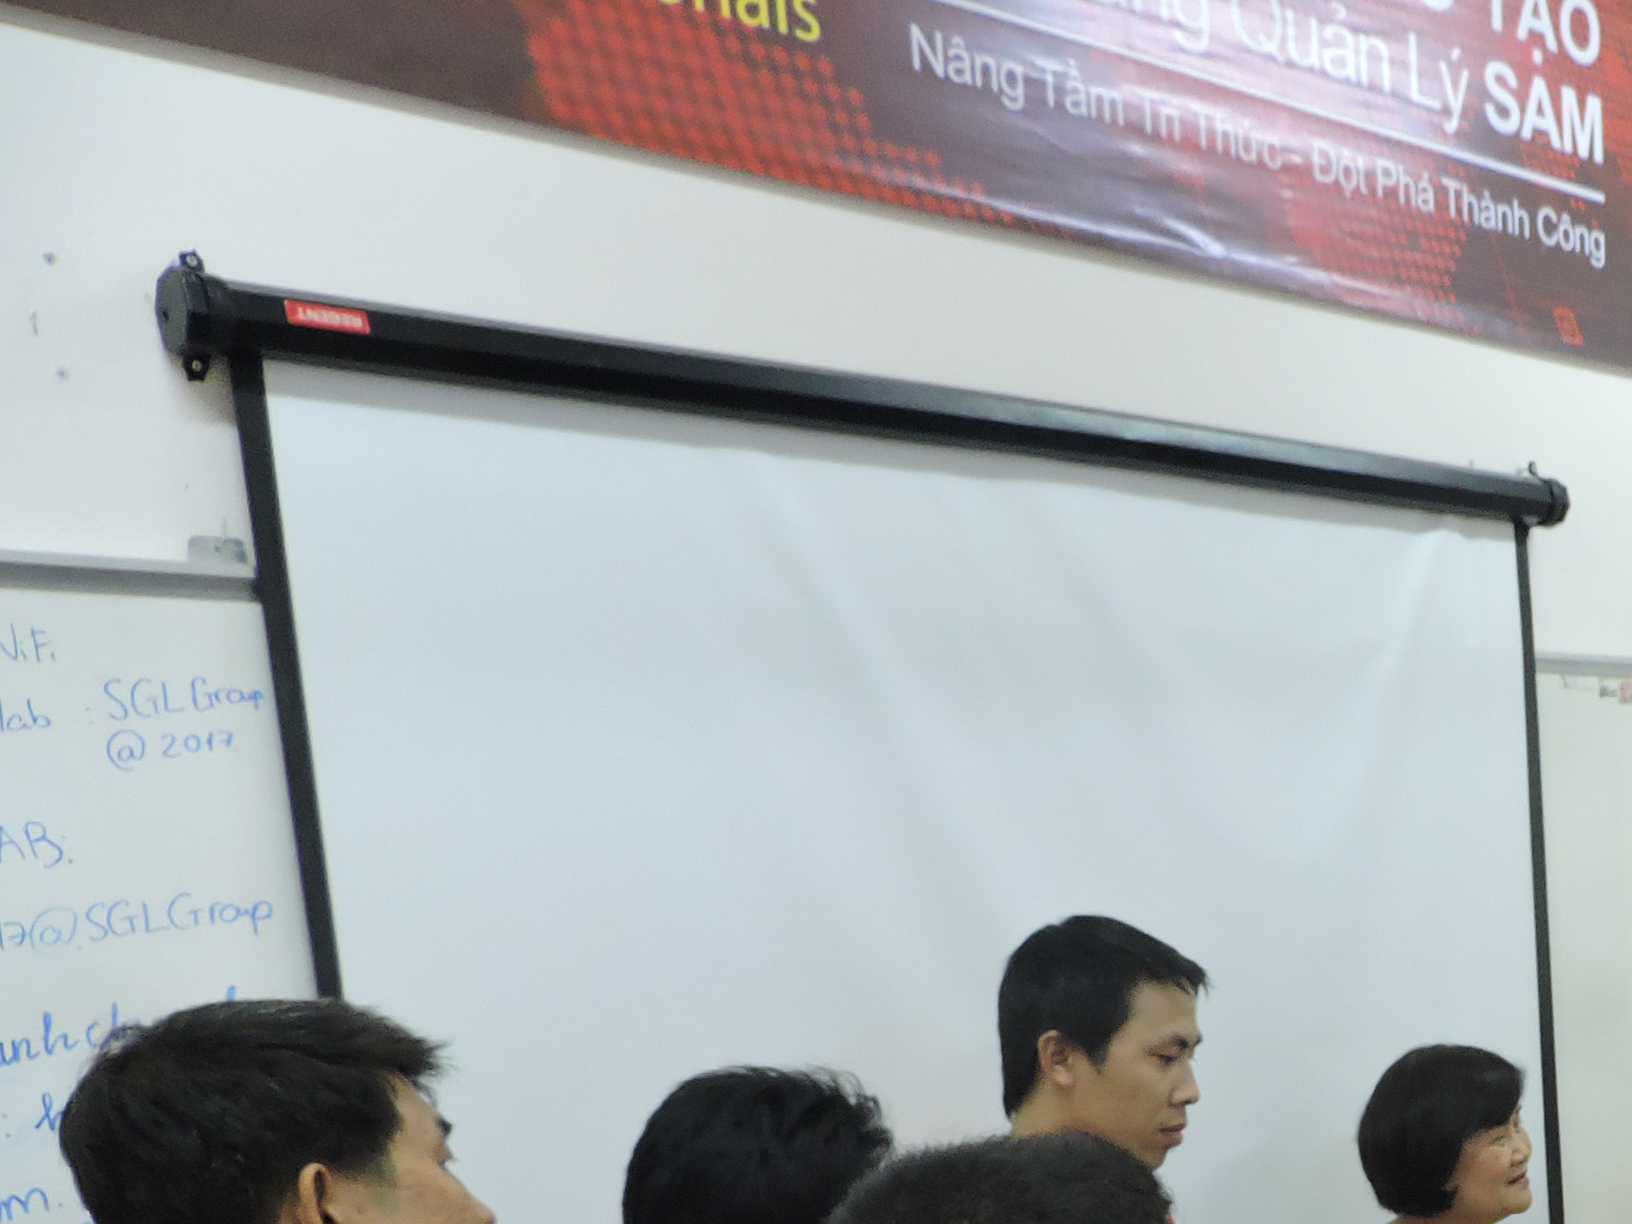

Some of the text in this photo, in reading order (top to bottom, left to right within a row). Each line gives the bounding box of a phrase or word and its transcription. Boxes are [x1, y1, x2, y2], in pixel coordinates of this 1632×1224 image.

[909, 22, 1027, 112] Nâng
[1030, 54, 1125, 127] Tầm
[1311, 139, 1369, 199] Đột
[1441, 175, 1531, 240] Thành
[1536, 205, 1606, 269] Công
[1408, 31, 1470, 135] Lý
[1483, 60, 1604, 165] SAM
[161, 731, 233, 759] 2017
